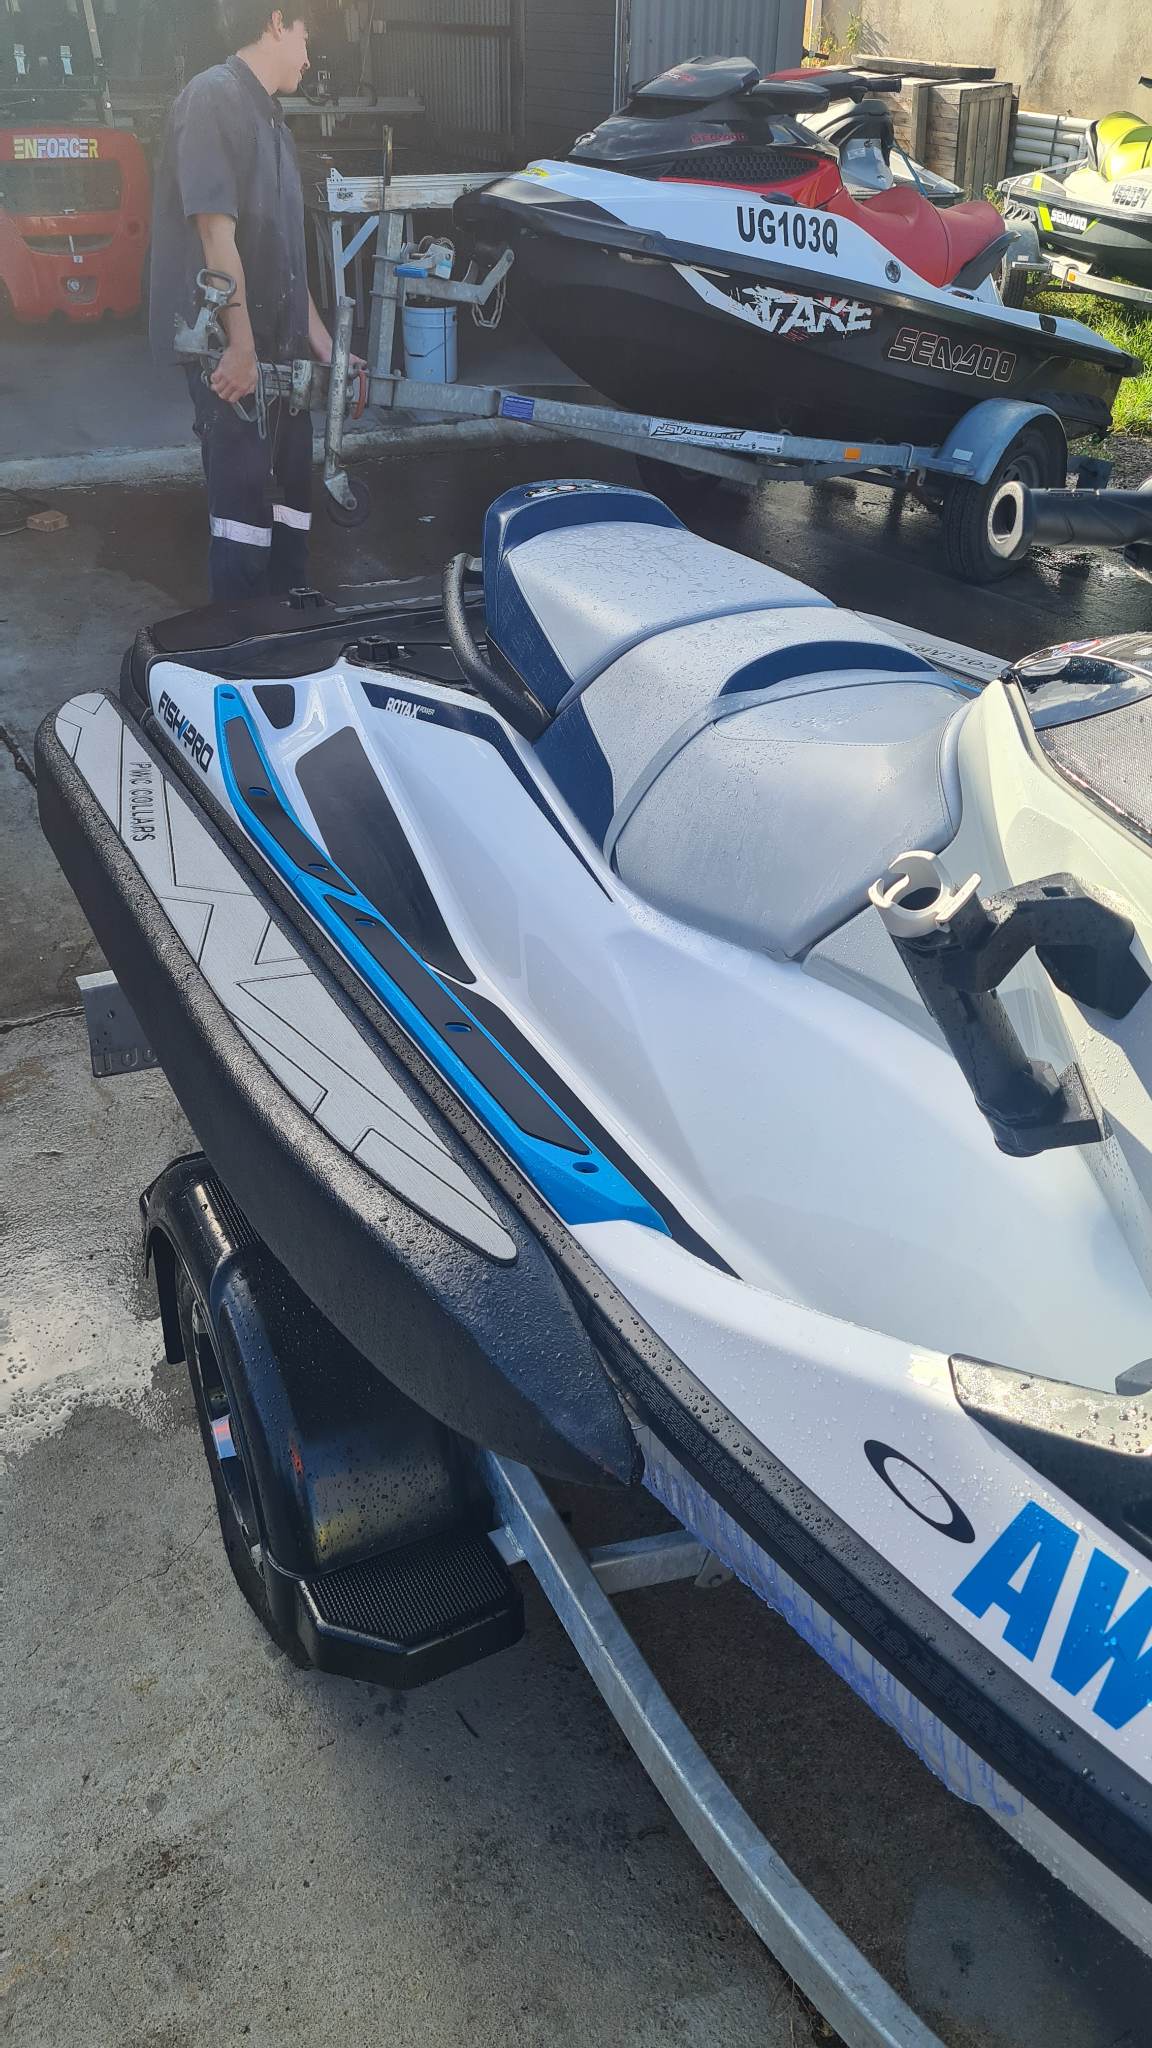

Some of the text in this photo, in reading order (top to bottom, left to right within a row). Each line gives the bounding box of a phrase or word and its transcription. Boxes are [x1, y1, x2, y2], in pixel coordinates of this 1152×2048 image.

[13, 137, 99, 159] ENFORCER
[736, 206, 839, 258] UG103Q
[741, 283, 873, 335] WAKE
[385, 696, 421, 720] ROTAX
[128, 761, 156, 842] PWC COLLARS
